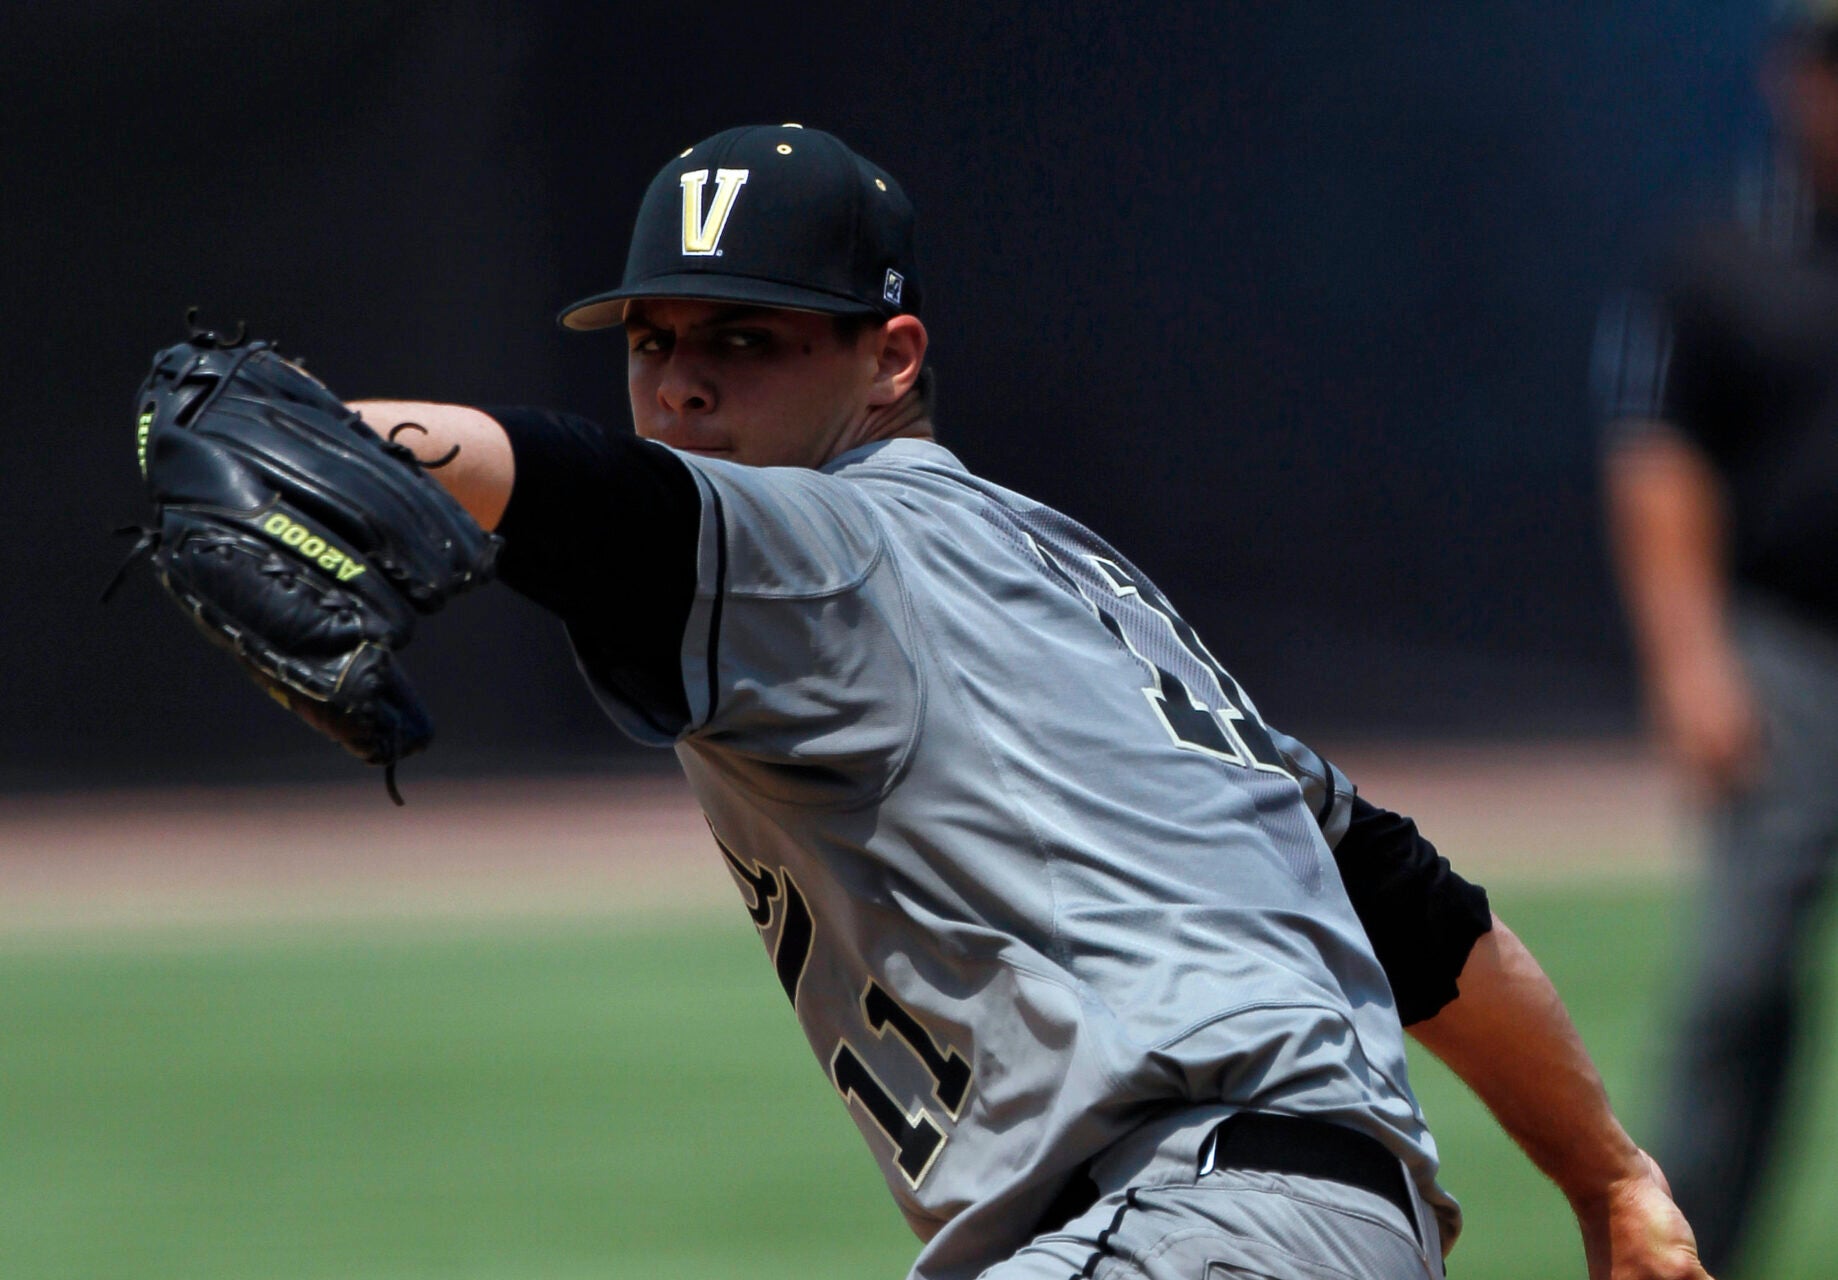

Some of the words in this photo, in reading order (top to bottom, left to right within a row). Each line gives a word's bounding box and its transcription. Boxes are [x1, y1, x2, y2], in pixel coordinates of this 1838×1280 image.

[680, 168, 749, 256] V
[263, 513, 367, 582] A2000
[830, 974, 974, 1192] 11
